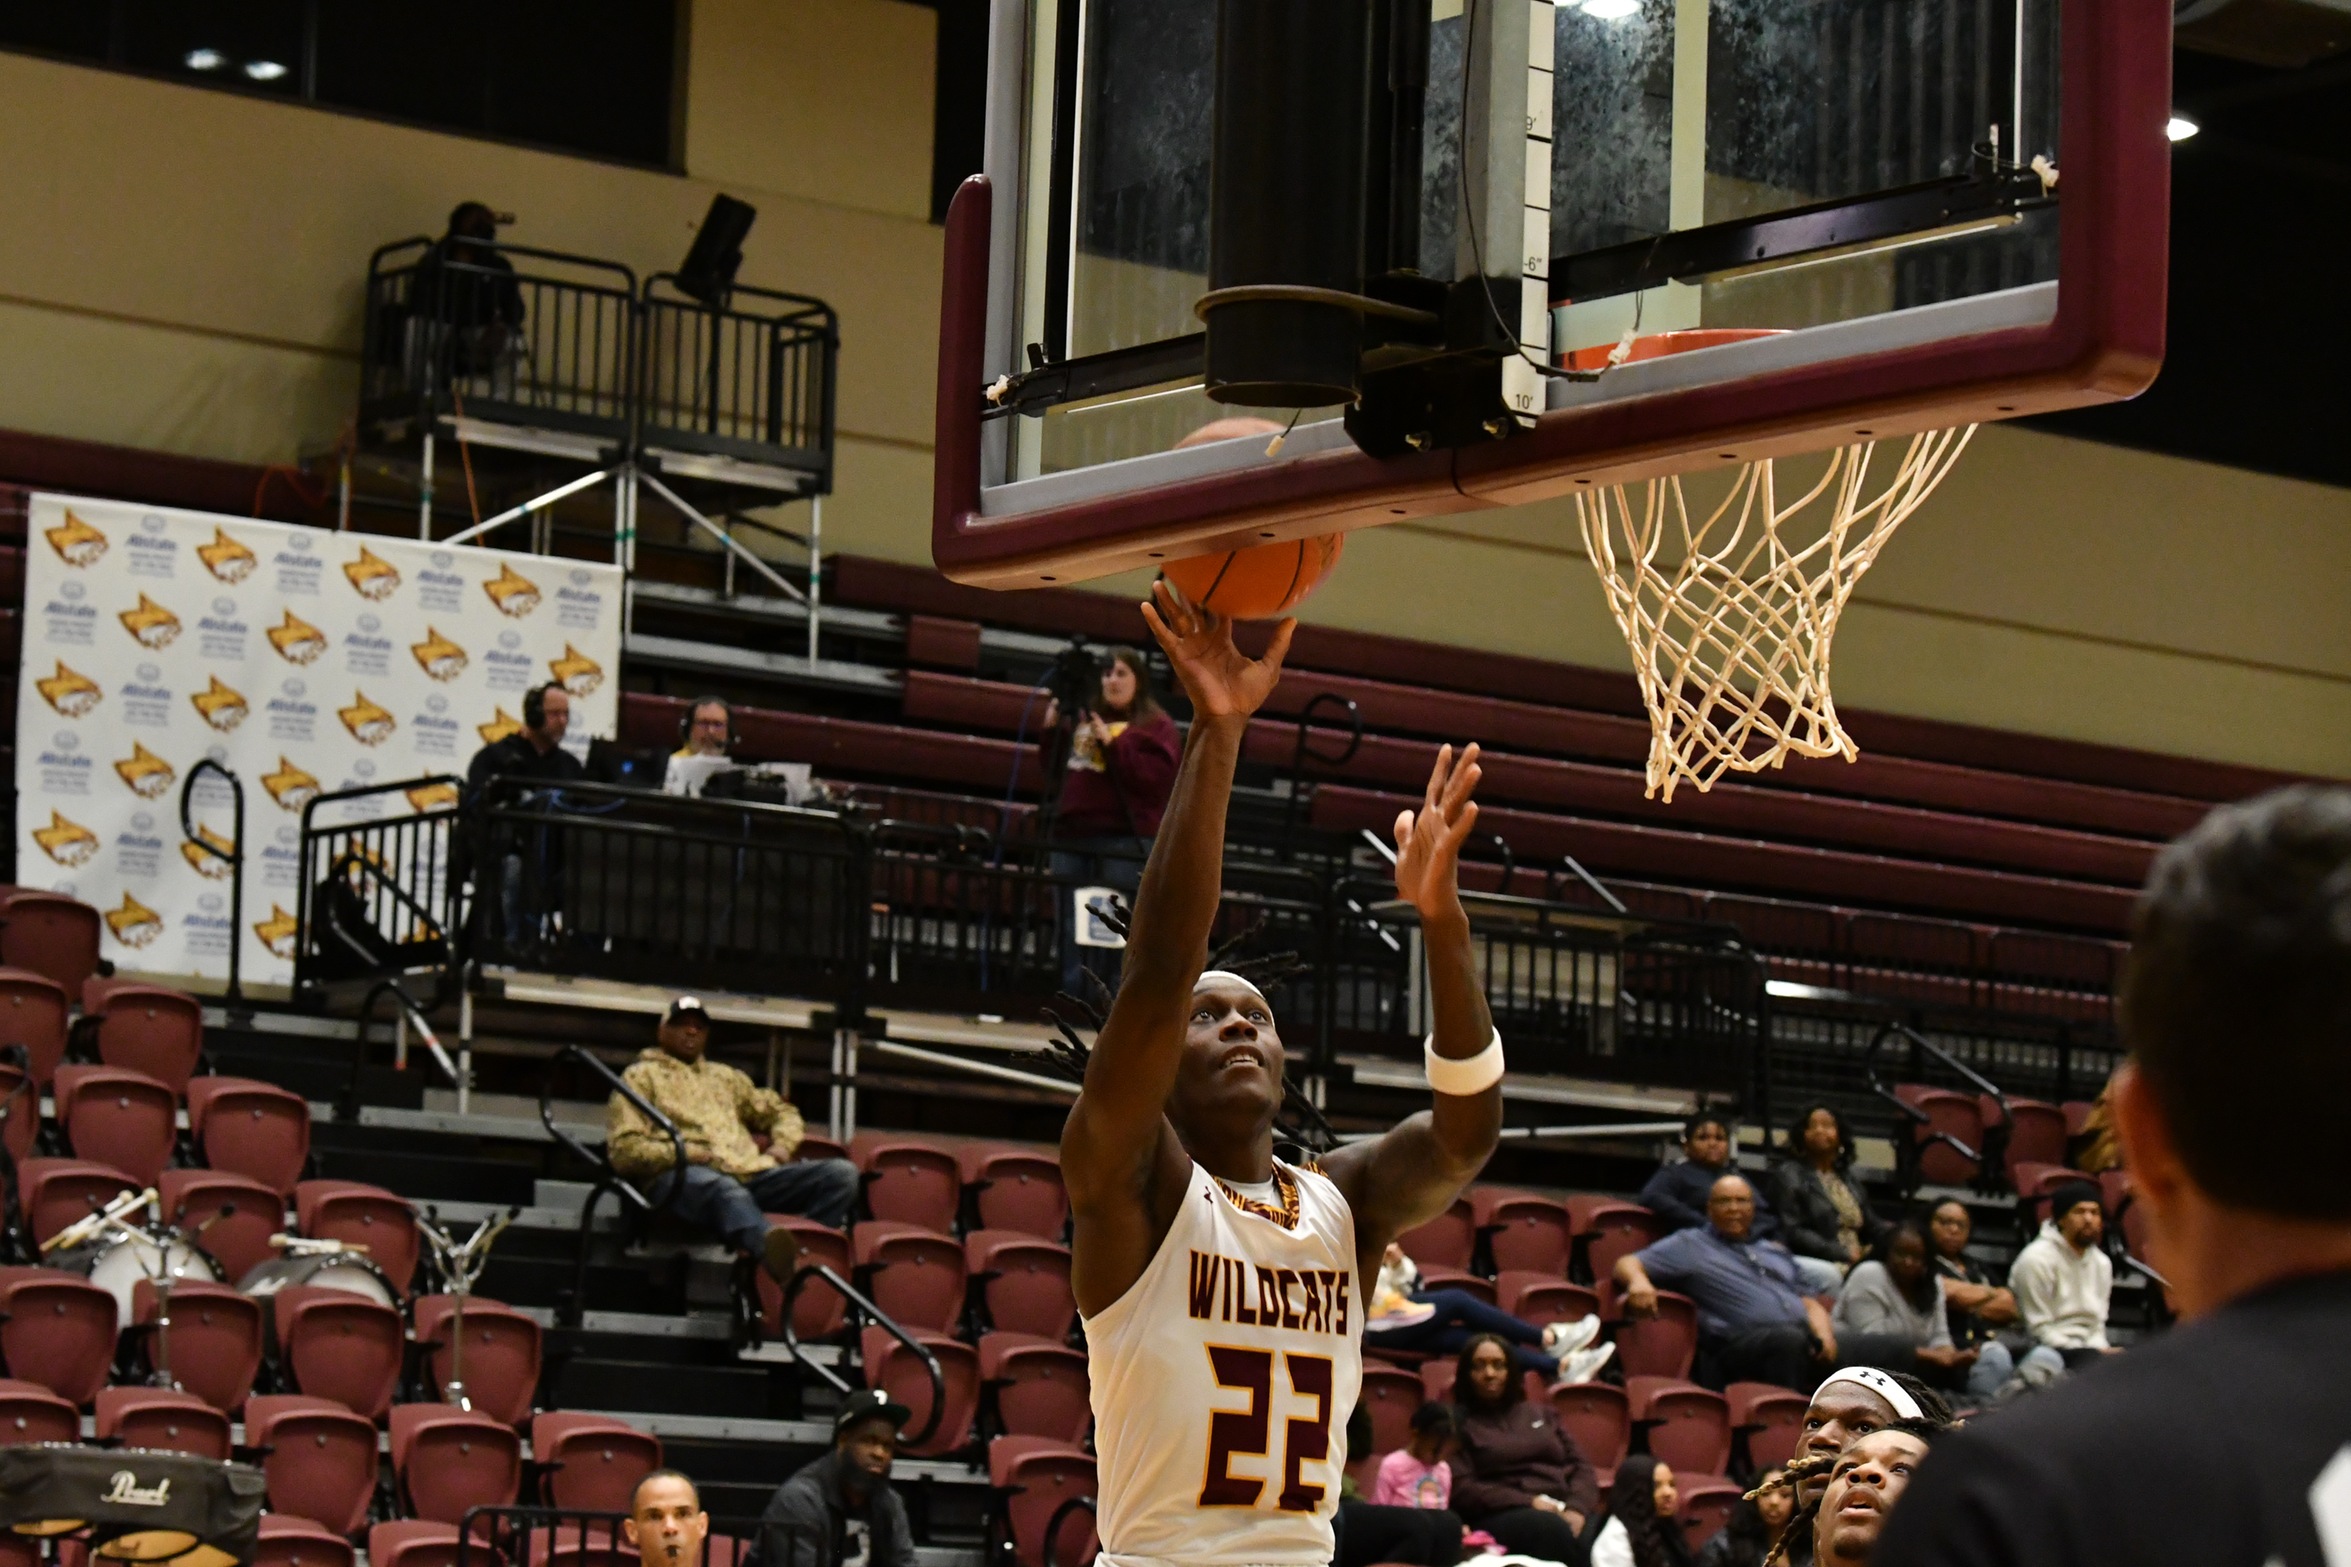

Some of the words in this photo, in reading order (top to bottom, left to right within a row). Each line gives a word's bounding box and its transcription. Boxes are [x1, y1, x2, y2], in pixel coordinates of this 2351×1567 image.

[1515, 393, 1534, 410] 10'
[1190, 1248, 1349, 1336] WILDCATS
[1197, 1342, 1334, 1515] 22
